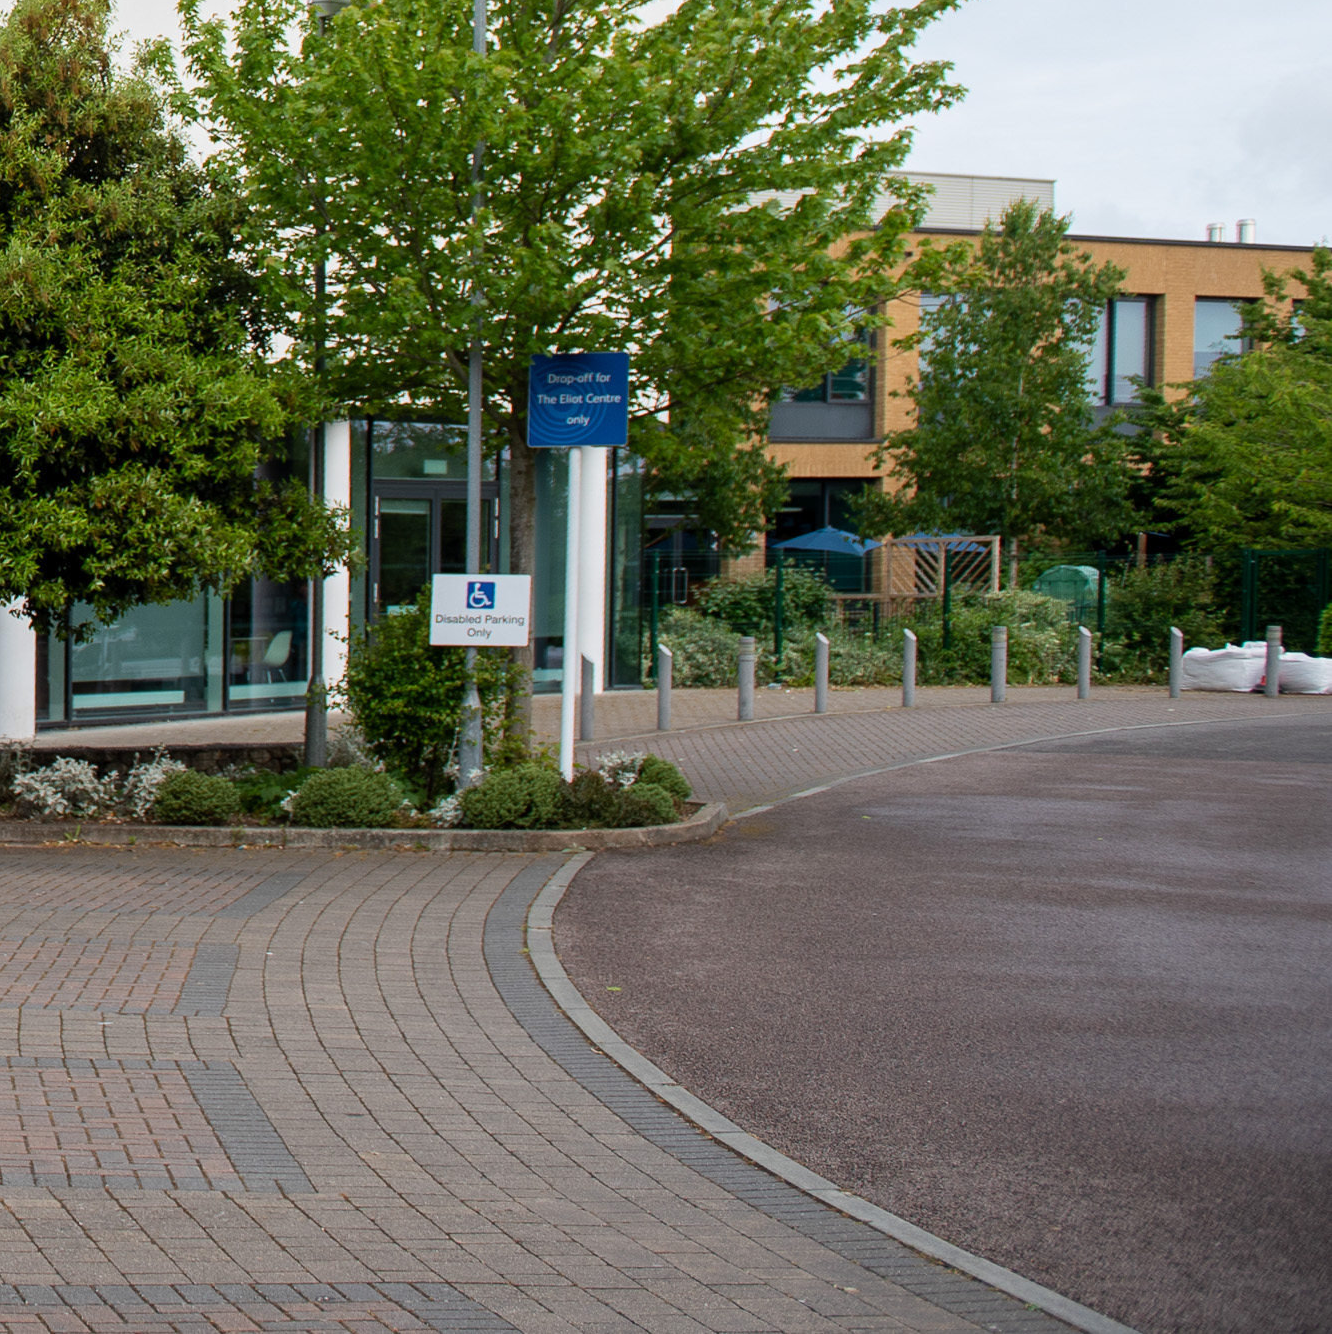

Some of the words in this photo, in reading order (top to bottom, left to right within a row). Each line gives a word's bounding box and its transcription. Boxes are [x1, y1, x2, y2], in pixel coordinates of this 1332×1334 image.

[548, 372, 594, 385] Drop-off
[596, 372, 611, 383] for
[537, 394, 558, 404] The
[559, 393, 583, 404] Eliot
[585, 393, 622, 404] Centre
[566, 414, 590, 426] only
[435, 614, 482, 624] Disabled
[485, 614, 525, 626] Parking
[467, 627, 492, 639] Only
